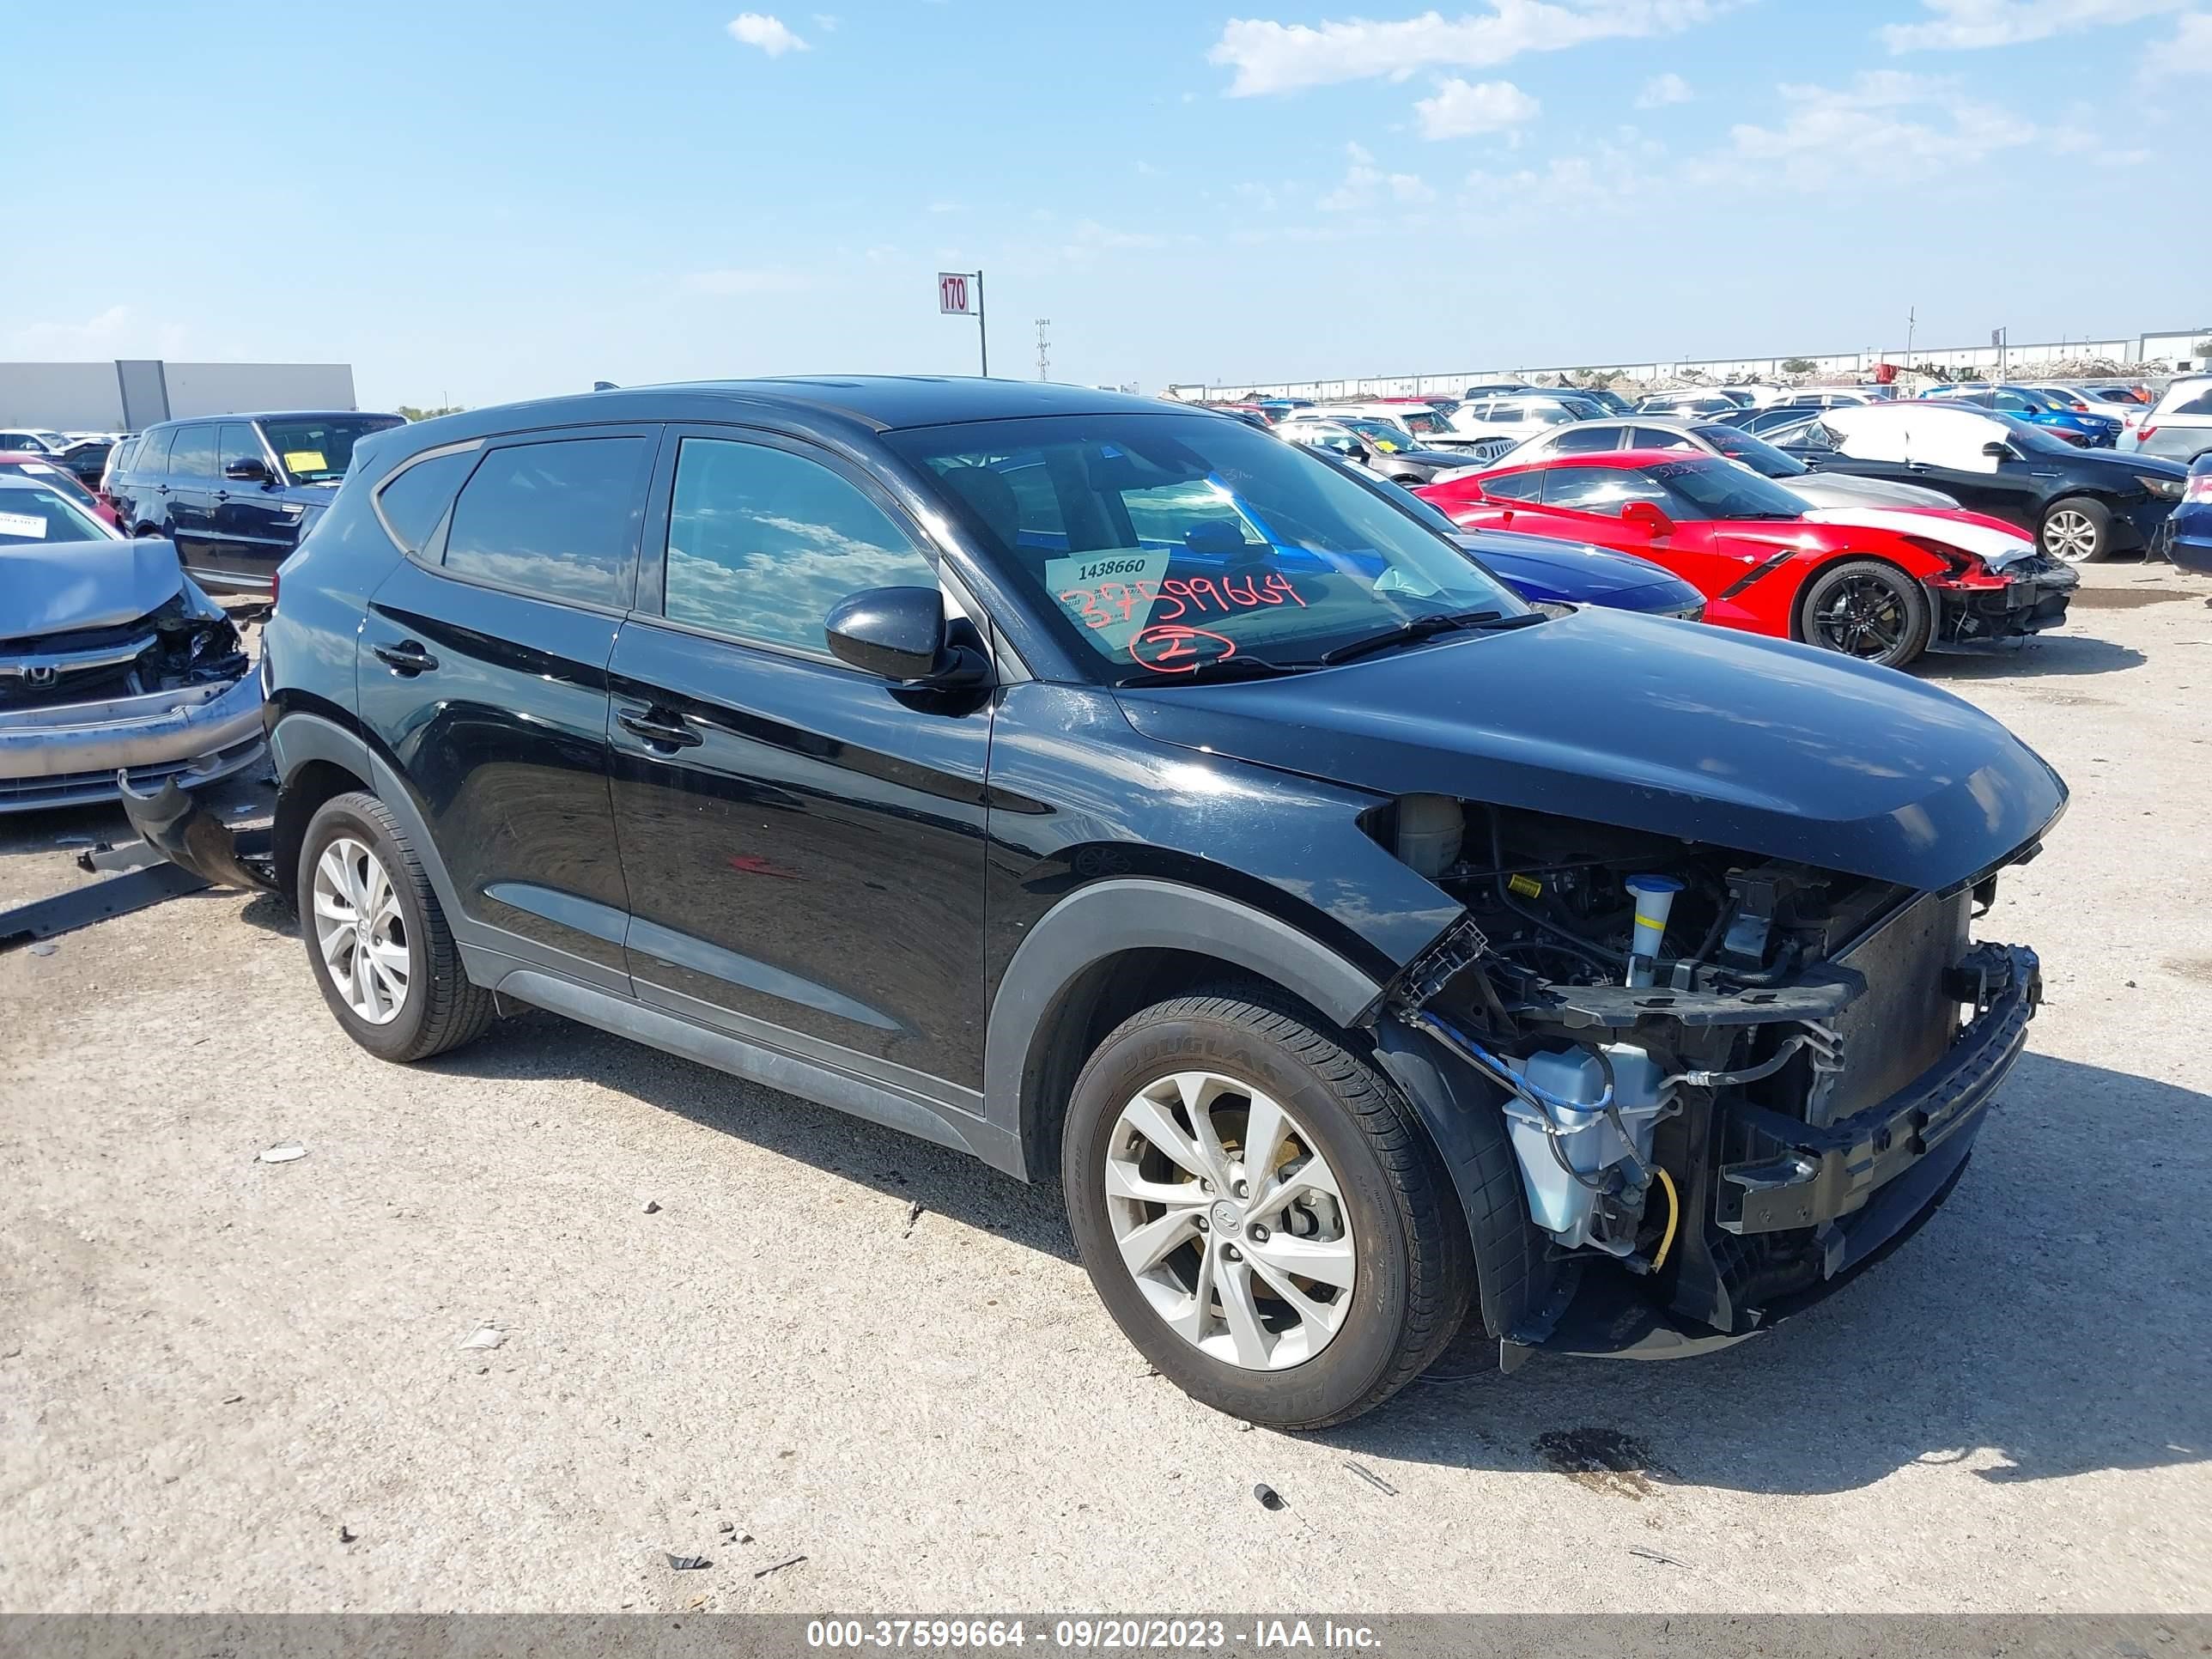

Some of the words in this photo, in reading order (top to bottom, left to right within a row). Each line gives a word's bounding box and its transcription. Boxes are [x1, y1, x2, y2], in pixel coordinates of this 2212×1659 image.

[942, 277, 965, 310] 170
[1079, 559, 1146, 580] 1438660
[1060, 573, 1310, 629] 37599664
